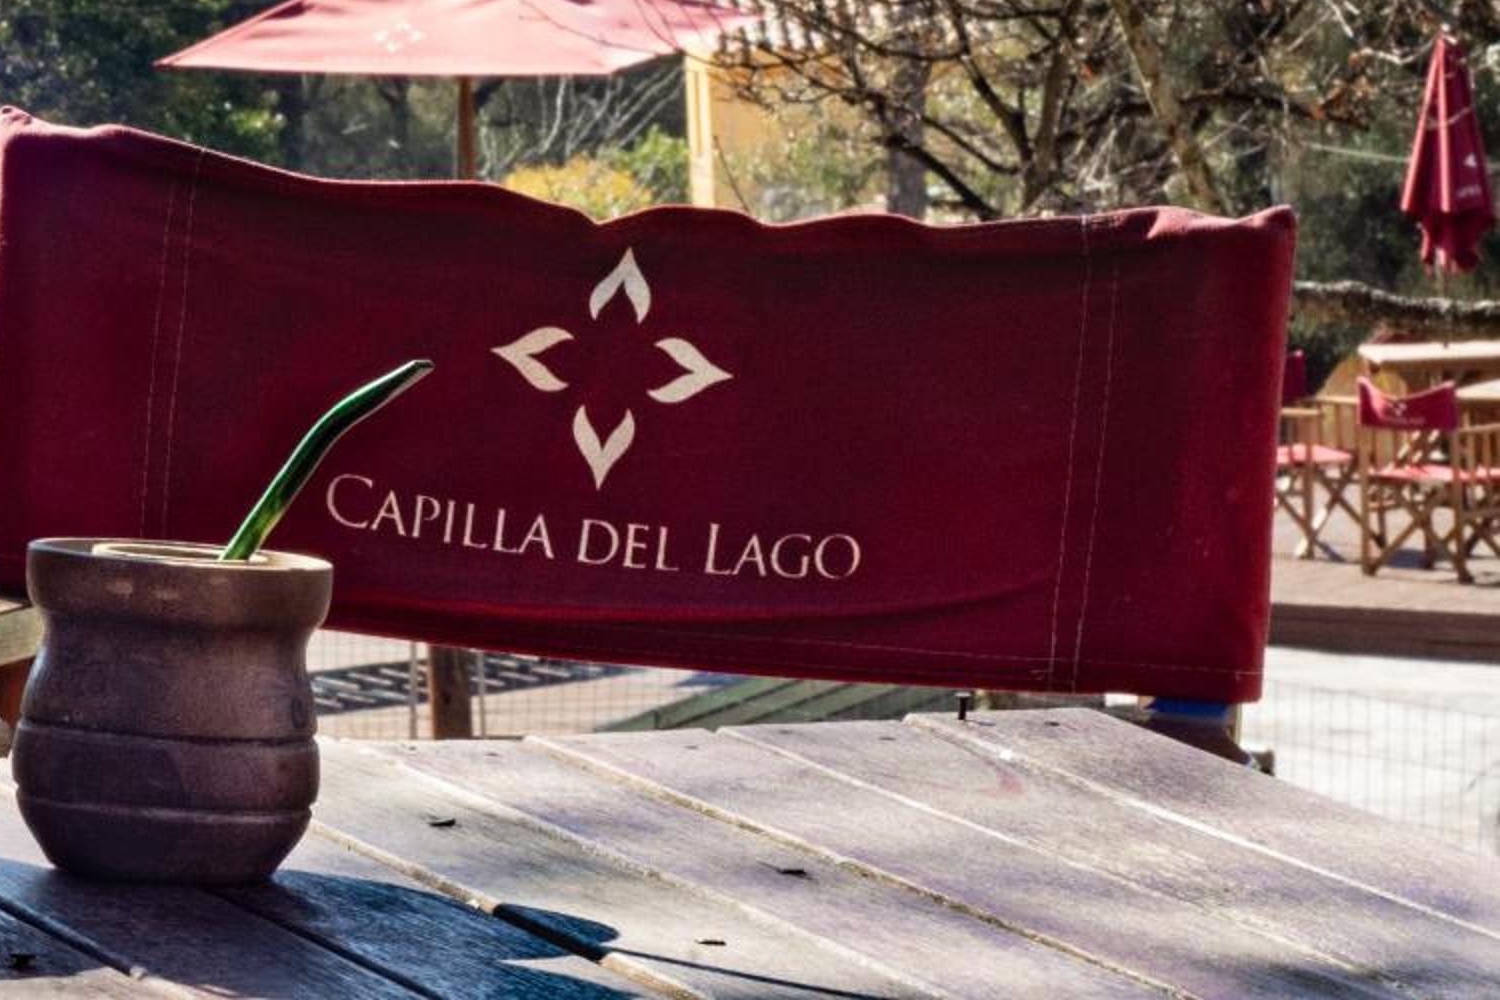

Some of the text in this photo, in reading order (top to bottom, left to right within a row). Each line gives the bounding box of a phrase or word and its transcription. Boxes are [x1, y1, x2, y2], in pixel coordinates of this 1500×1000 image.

[326, 473, 861, 579] CAPILLA DEL LAGO
